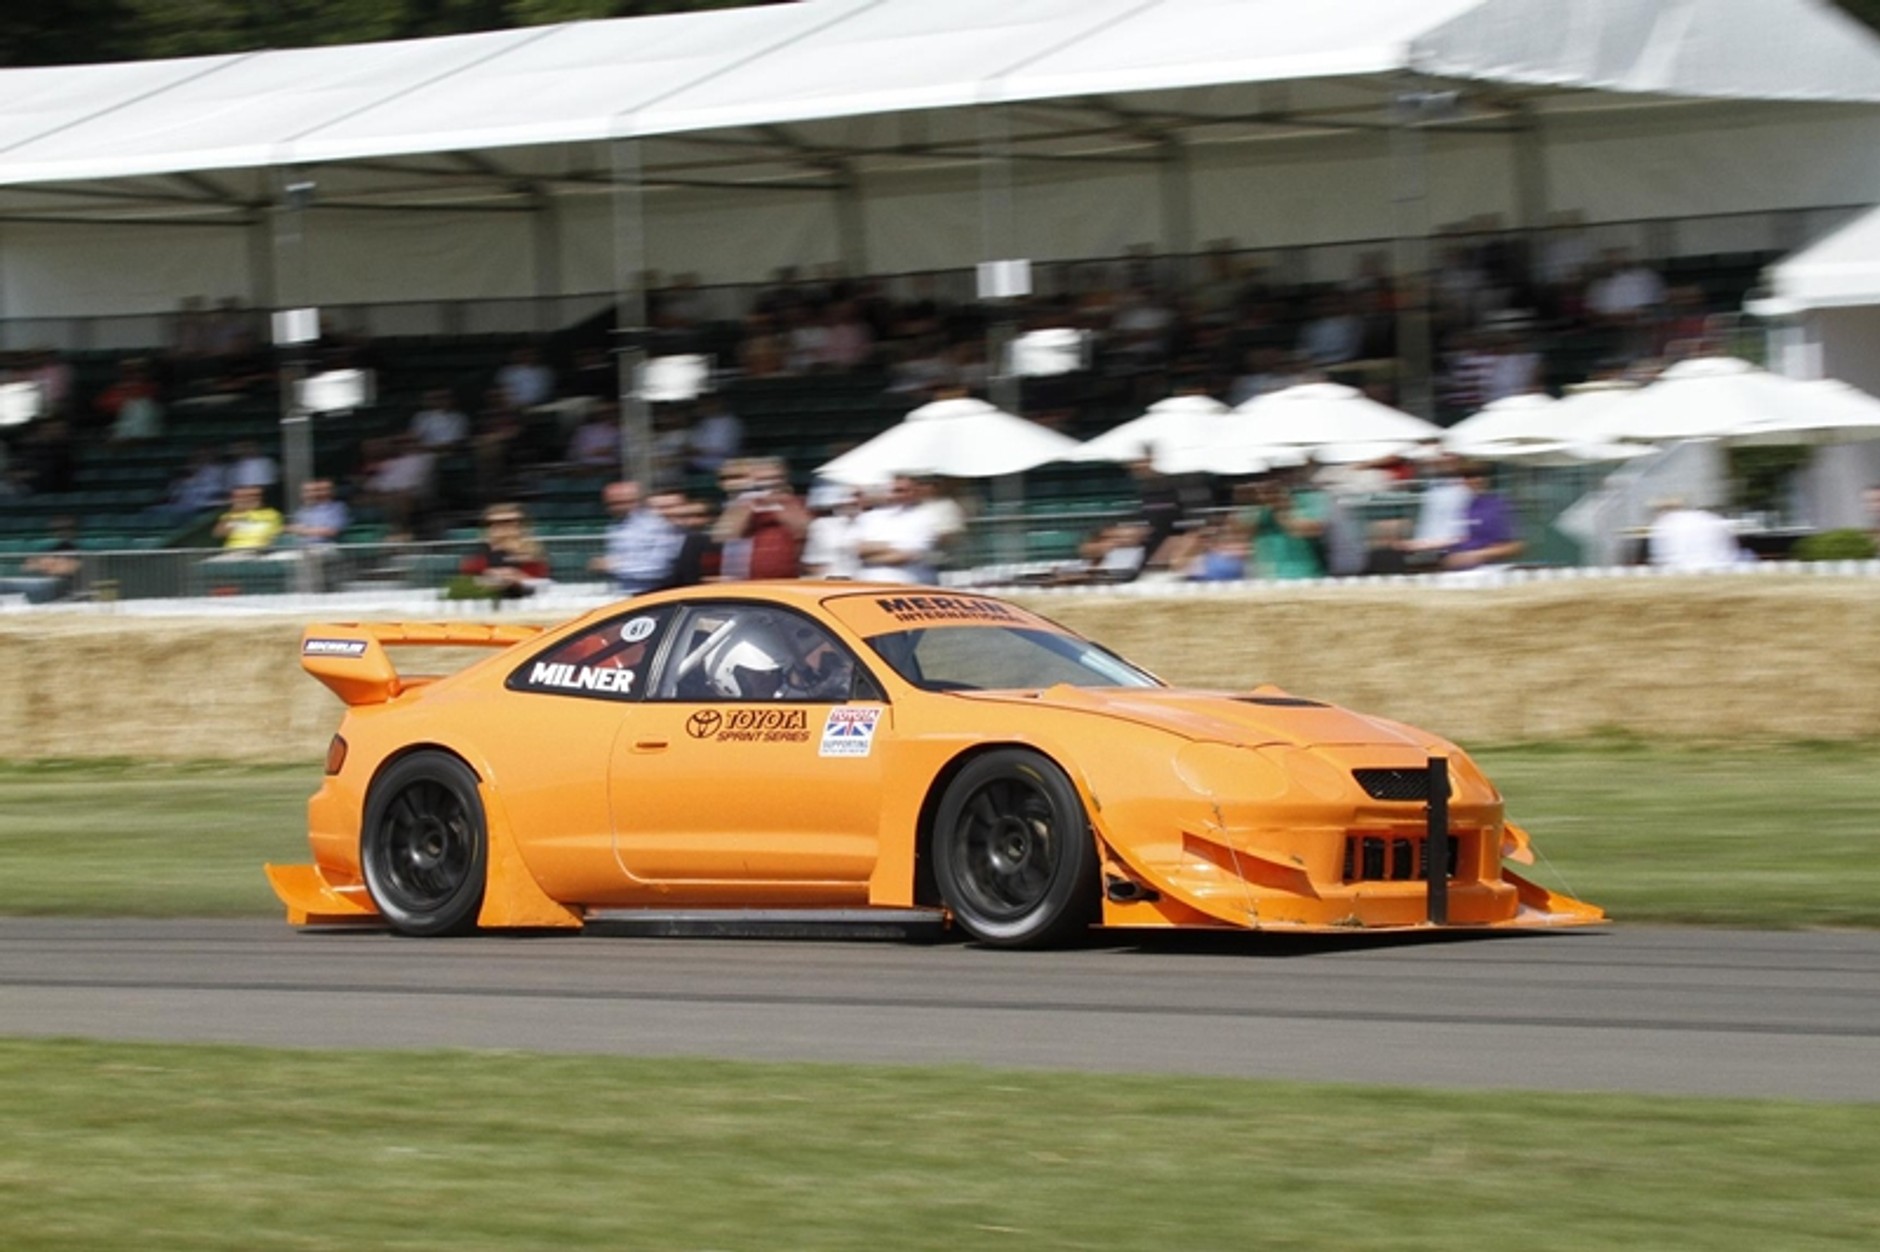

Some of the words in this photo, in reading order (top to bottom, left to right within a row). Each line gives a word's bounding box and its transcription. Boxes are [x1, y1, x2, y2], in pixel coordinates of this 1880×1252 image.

[876, 597, 1008, 613] MERLIN
[529, 662, 635, 693] MILNER
[724, 709, 807, 730] TOYOTA
[716, 731, 761, 742] SPRINT
[762, 731, 811, 742] SERIES
